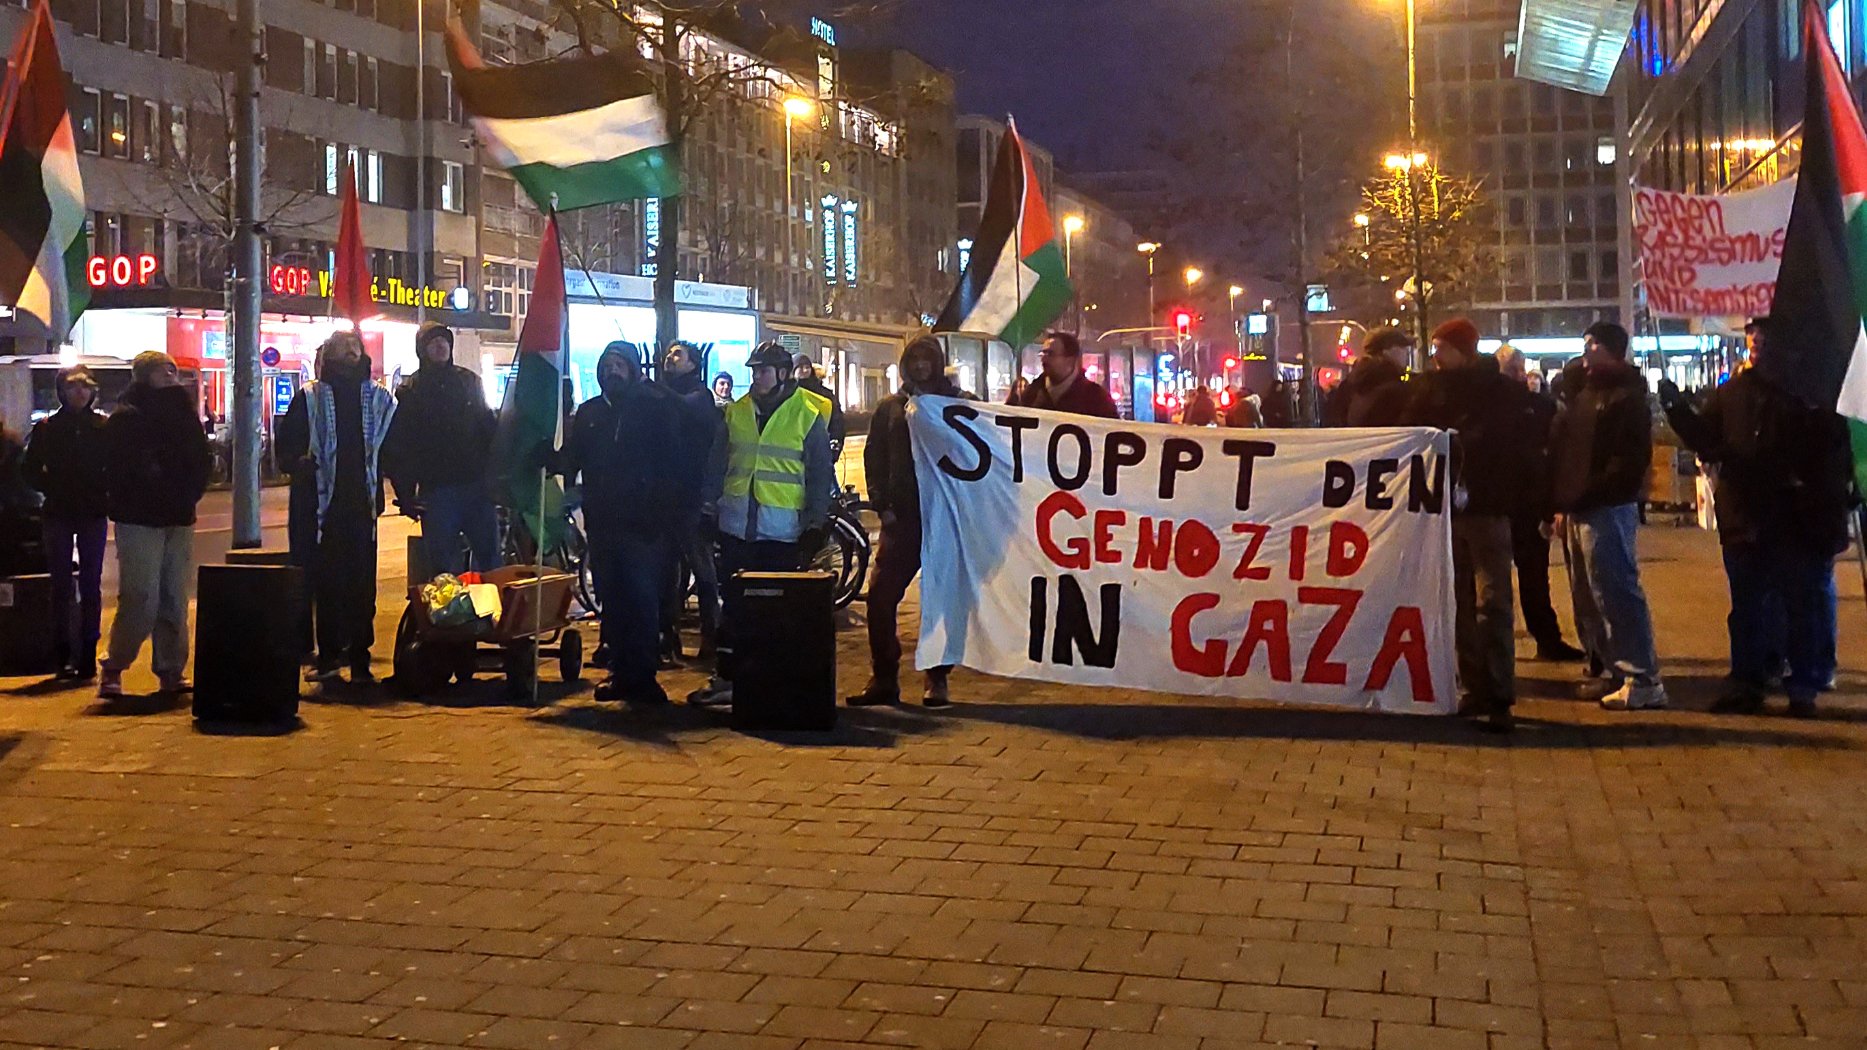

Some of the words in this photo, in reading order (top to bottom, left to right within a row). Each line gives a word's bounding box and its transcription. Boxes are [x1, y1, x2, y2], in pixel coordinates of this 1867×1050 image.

[811, 16, 836, 46] HOTEL
[87, 254, 158, 288] GOP
[824, 209, 836, 278] KAISERHOF
[844, 214, 856, 281] KAISERHOF
[1642, 258, 1697, 287] UND
[271, 265, 311, 296] GOP
[318, 271, 446, 308] Vaé-Theater
[938, 405, 1275, 511] STOPPT
[1322, 454, 1446, 514] DEN
[1035, 490, 1370, 581] GENOZID
[1028, 574, 1122, 669] IN
[1170, 586, 1435, 703] GAZA
